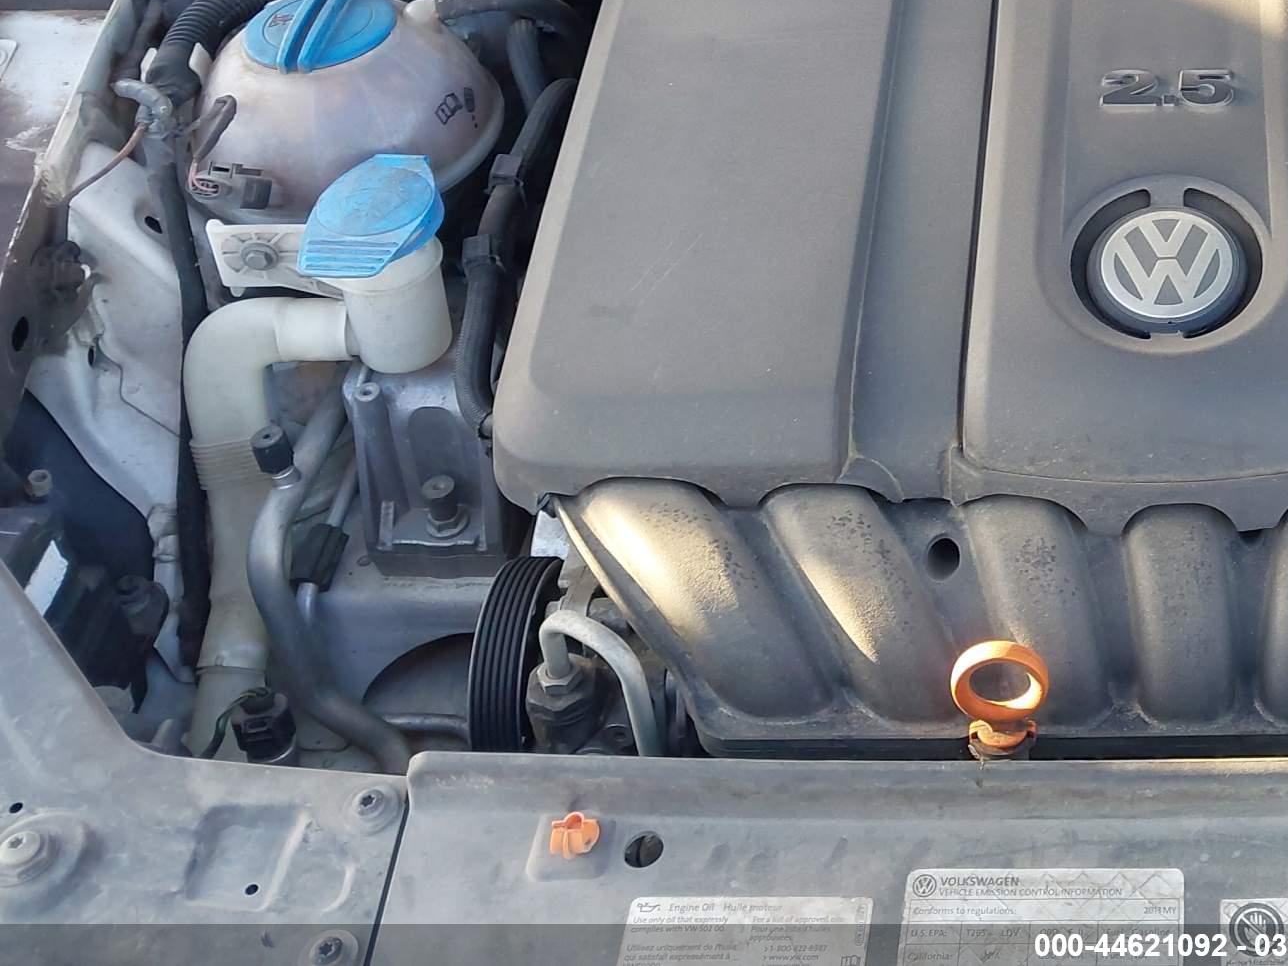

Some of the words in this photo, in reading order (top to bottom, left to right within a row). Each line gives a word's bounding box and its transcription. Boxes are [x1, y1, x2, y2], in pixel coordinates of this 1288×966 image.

[1101, 69, 1234, 107] 2.5
[941, 876, 1020, 887] VOLKSWAGEN
[940, 888, 973, 896] VEHICLE
[975, 888, 1017, 896] EMISSION
[1019, 888, 1058, 896] CONTROL
[1062, 888, 1122, 896] INFORMATION
[669, 903, 699, 915] Engine
[702, 902, 714, 912] Oil
[913, 906, 954, 915] Conforms
[956, 907, 967, 915] to
[968, 907, 1017, 916] regulations:
[648, 916, 665, 925] only
[666, 915, 676, 923] oil
[677, 915, 693, 923] that
[694, 915, 729, 924] expressly
